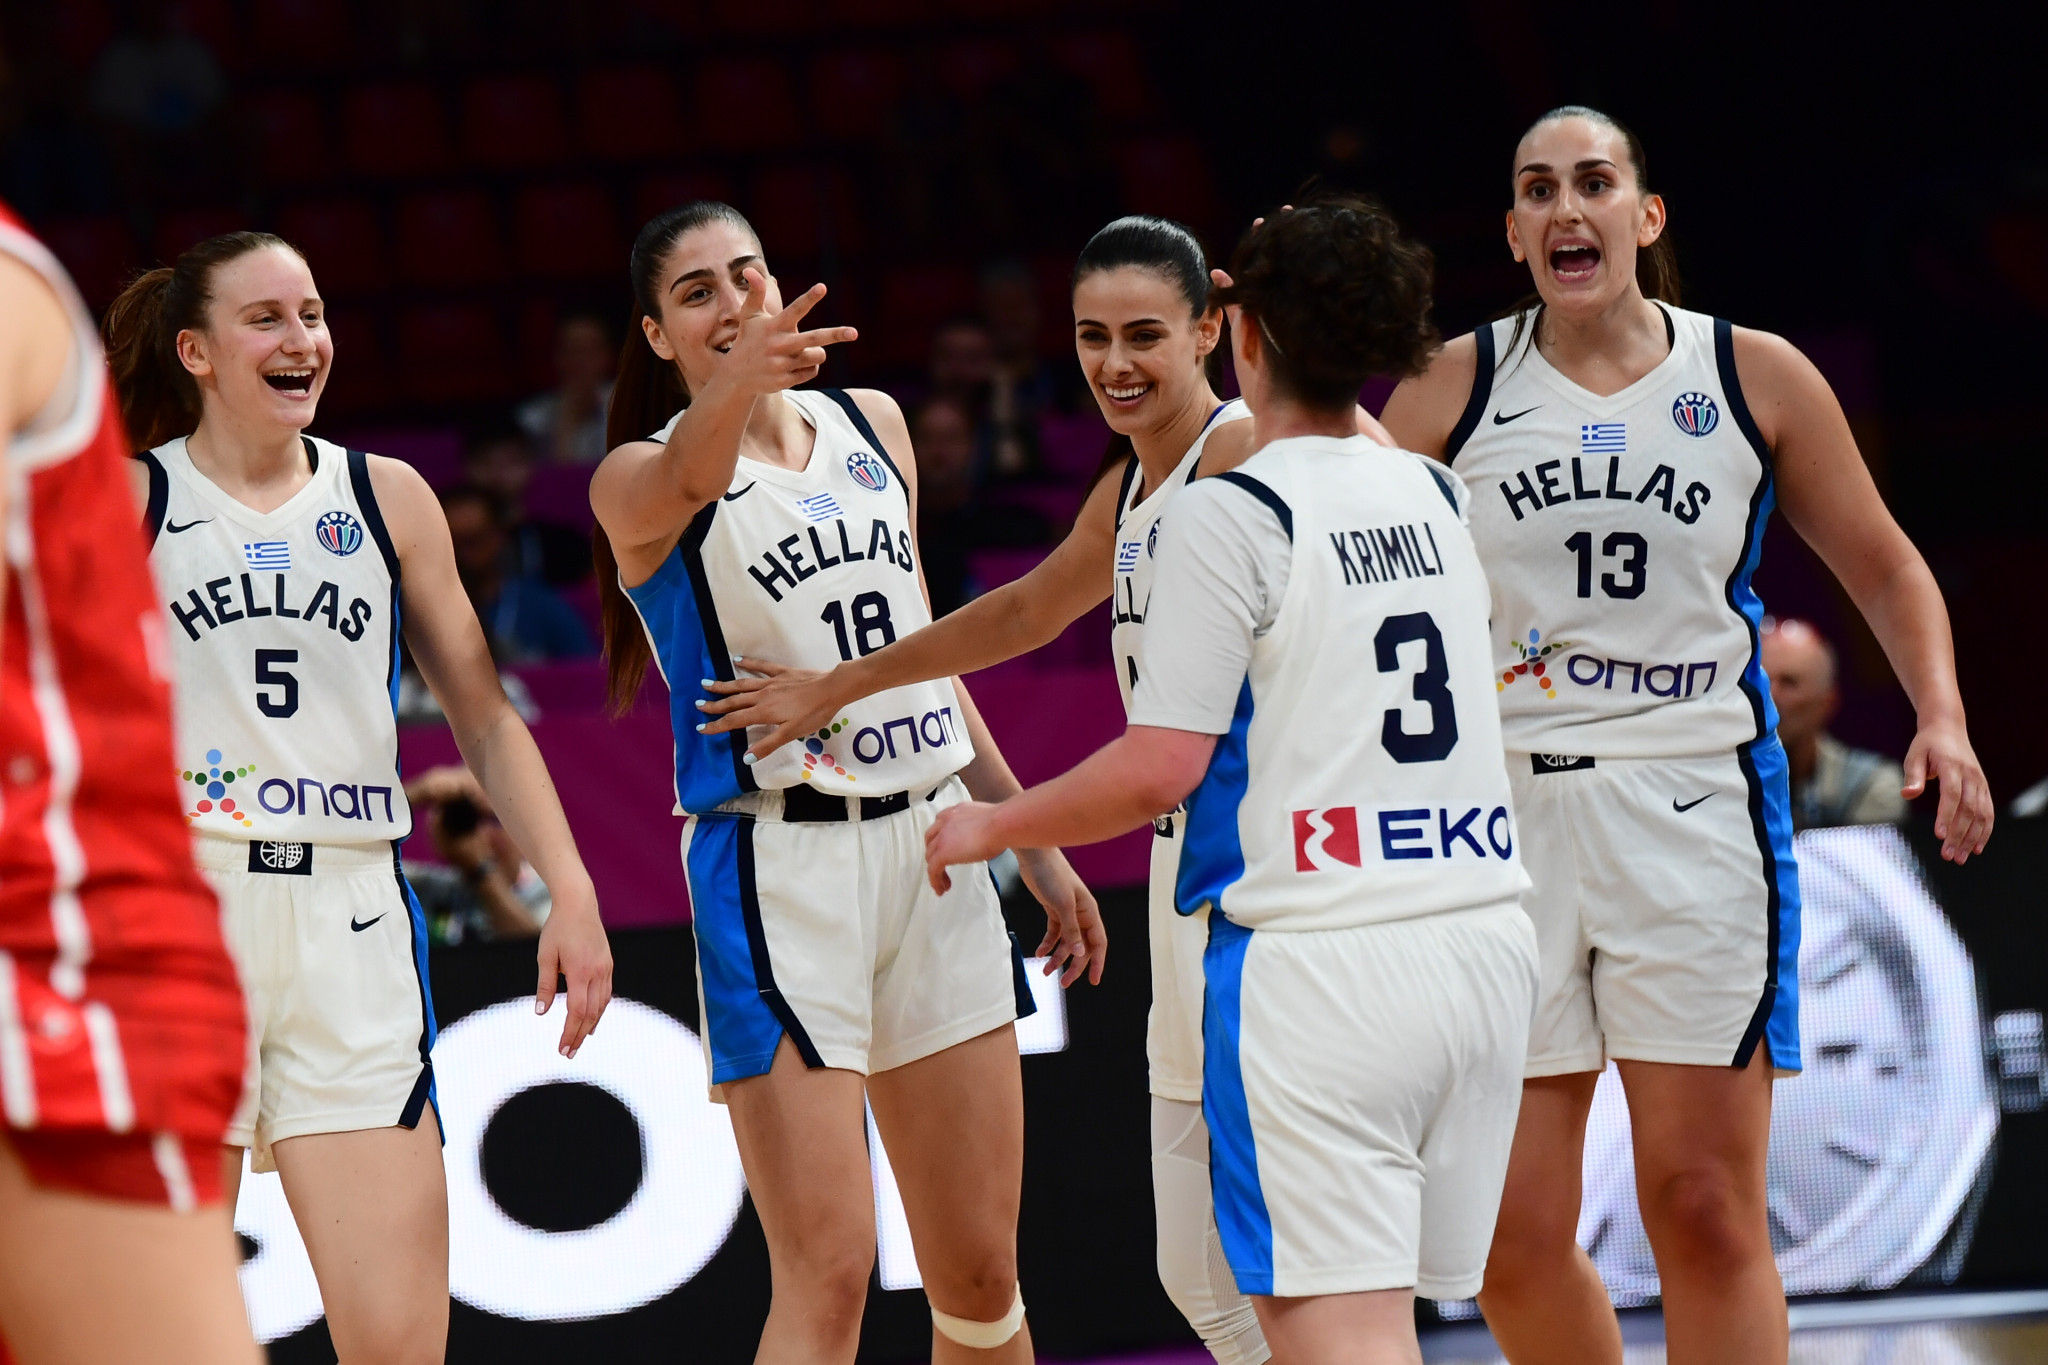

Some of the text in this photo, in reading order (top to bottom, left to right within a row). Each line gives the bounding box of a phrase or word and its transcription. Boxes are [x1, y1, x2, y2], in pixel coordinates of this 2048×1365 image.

[1499, 455, 1711, 525] HELLAS
[747, 519, 913, 602] HELLAS
[1329, 522, 1444, 586] KRIMILI
[1564, 531, 1648, 600] 13
[169, 572, 372, 643] HELLAS
[820, 590, 897, 662] 18
[255, 648, 299, 719] 5
[1373, 611, 1459, 764] 3
[1377, 805, 1513, 861] EKO
